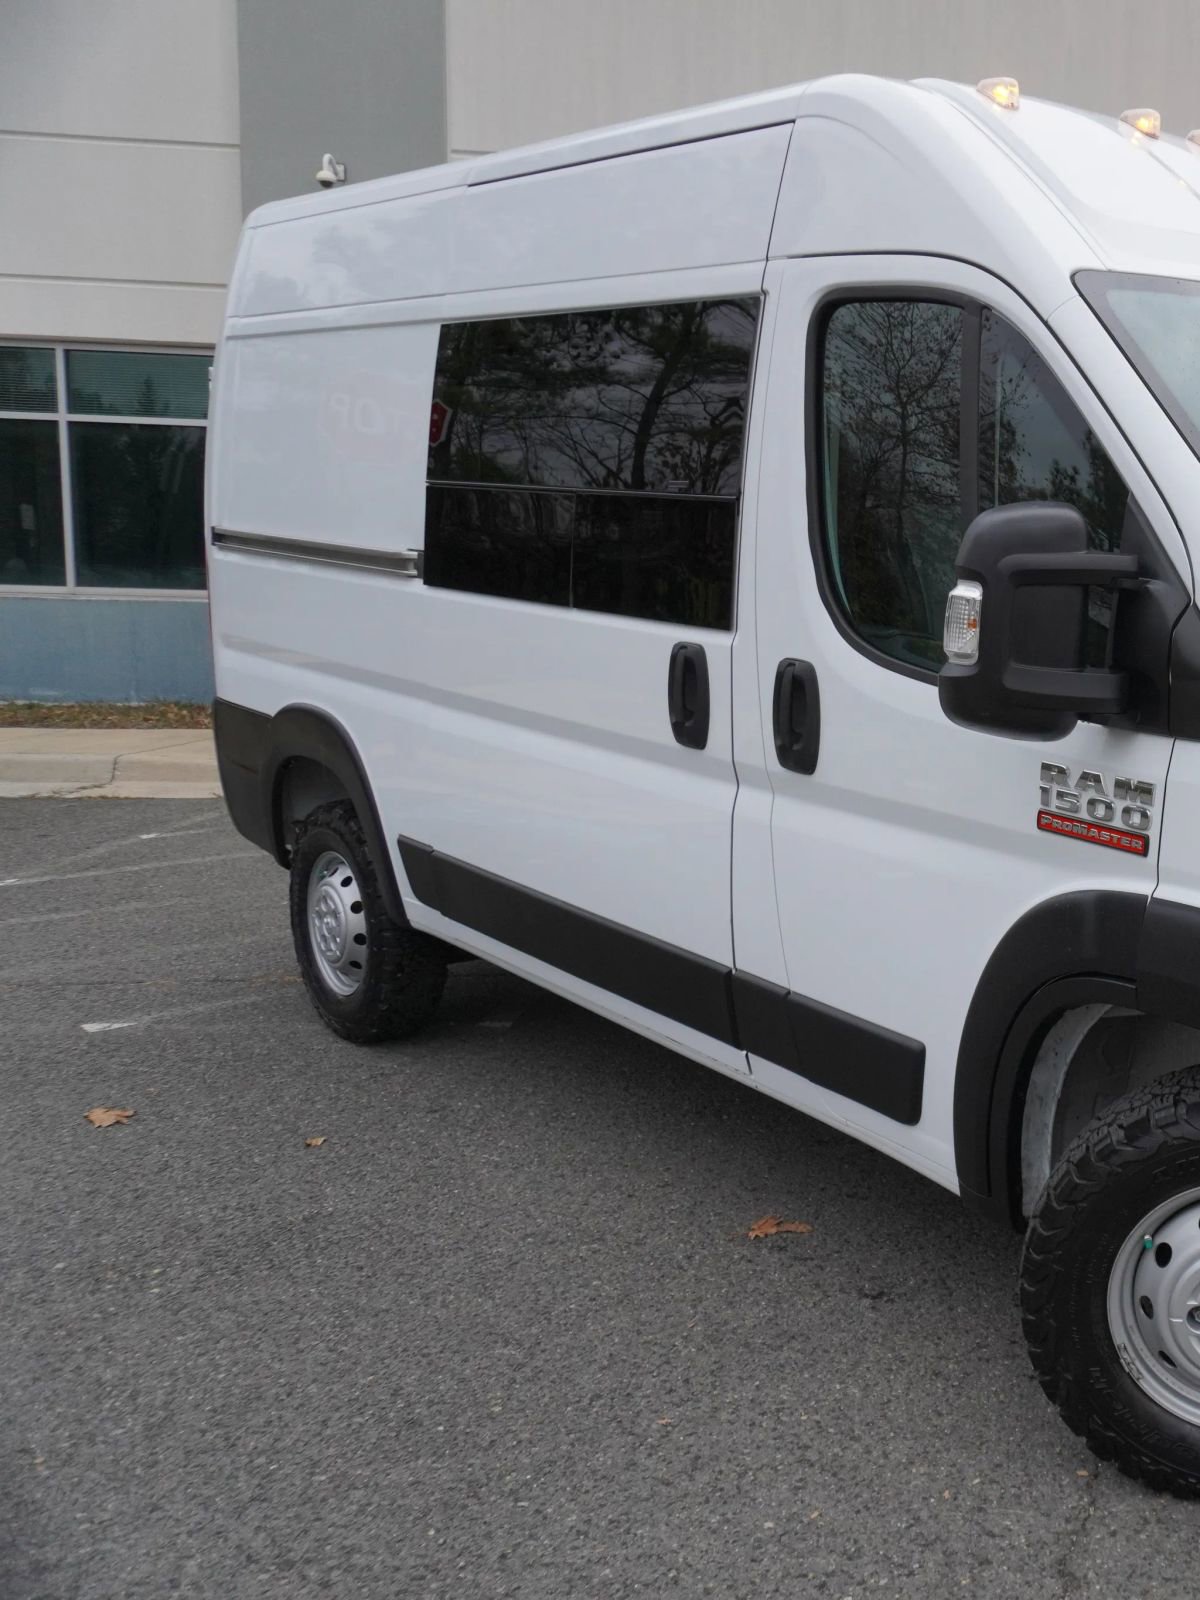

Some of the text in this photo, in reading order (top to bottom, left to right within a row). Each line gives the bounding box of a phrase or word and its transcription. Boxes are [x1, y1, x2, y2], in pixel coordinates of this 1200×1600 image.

[1039, 761, 1157, 808] RAM
[1039, 785, 1152, 831] 1500
[1040, 813, 1143, 850] PROMASTER
